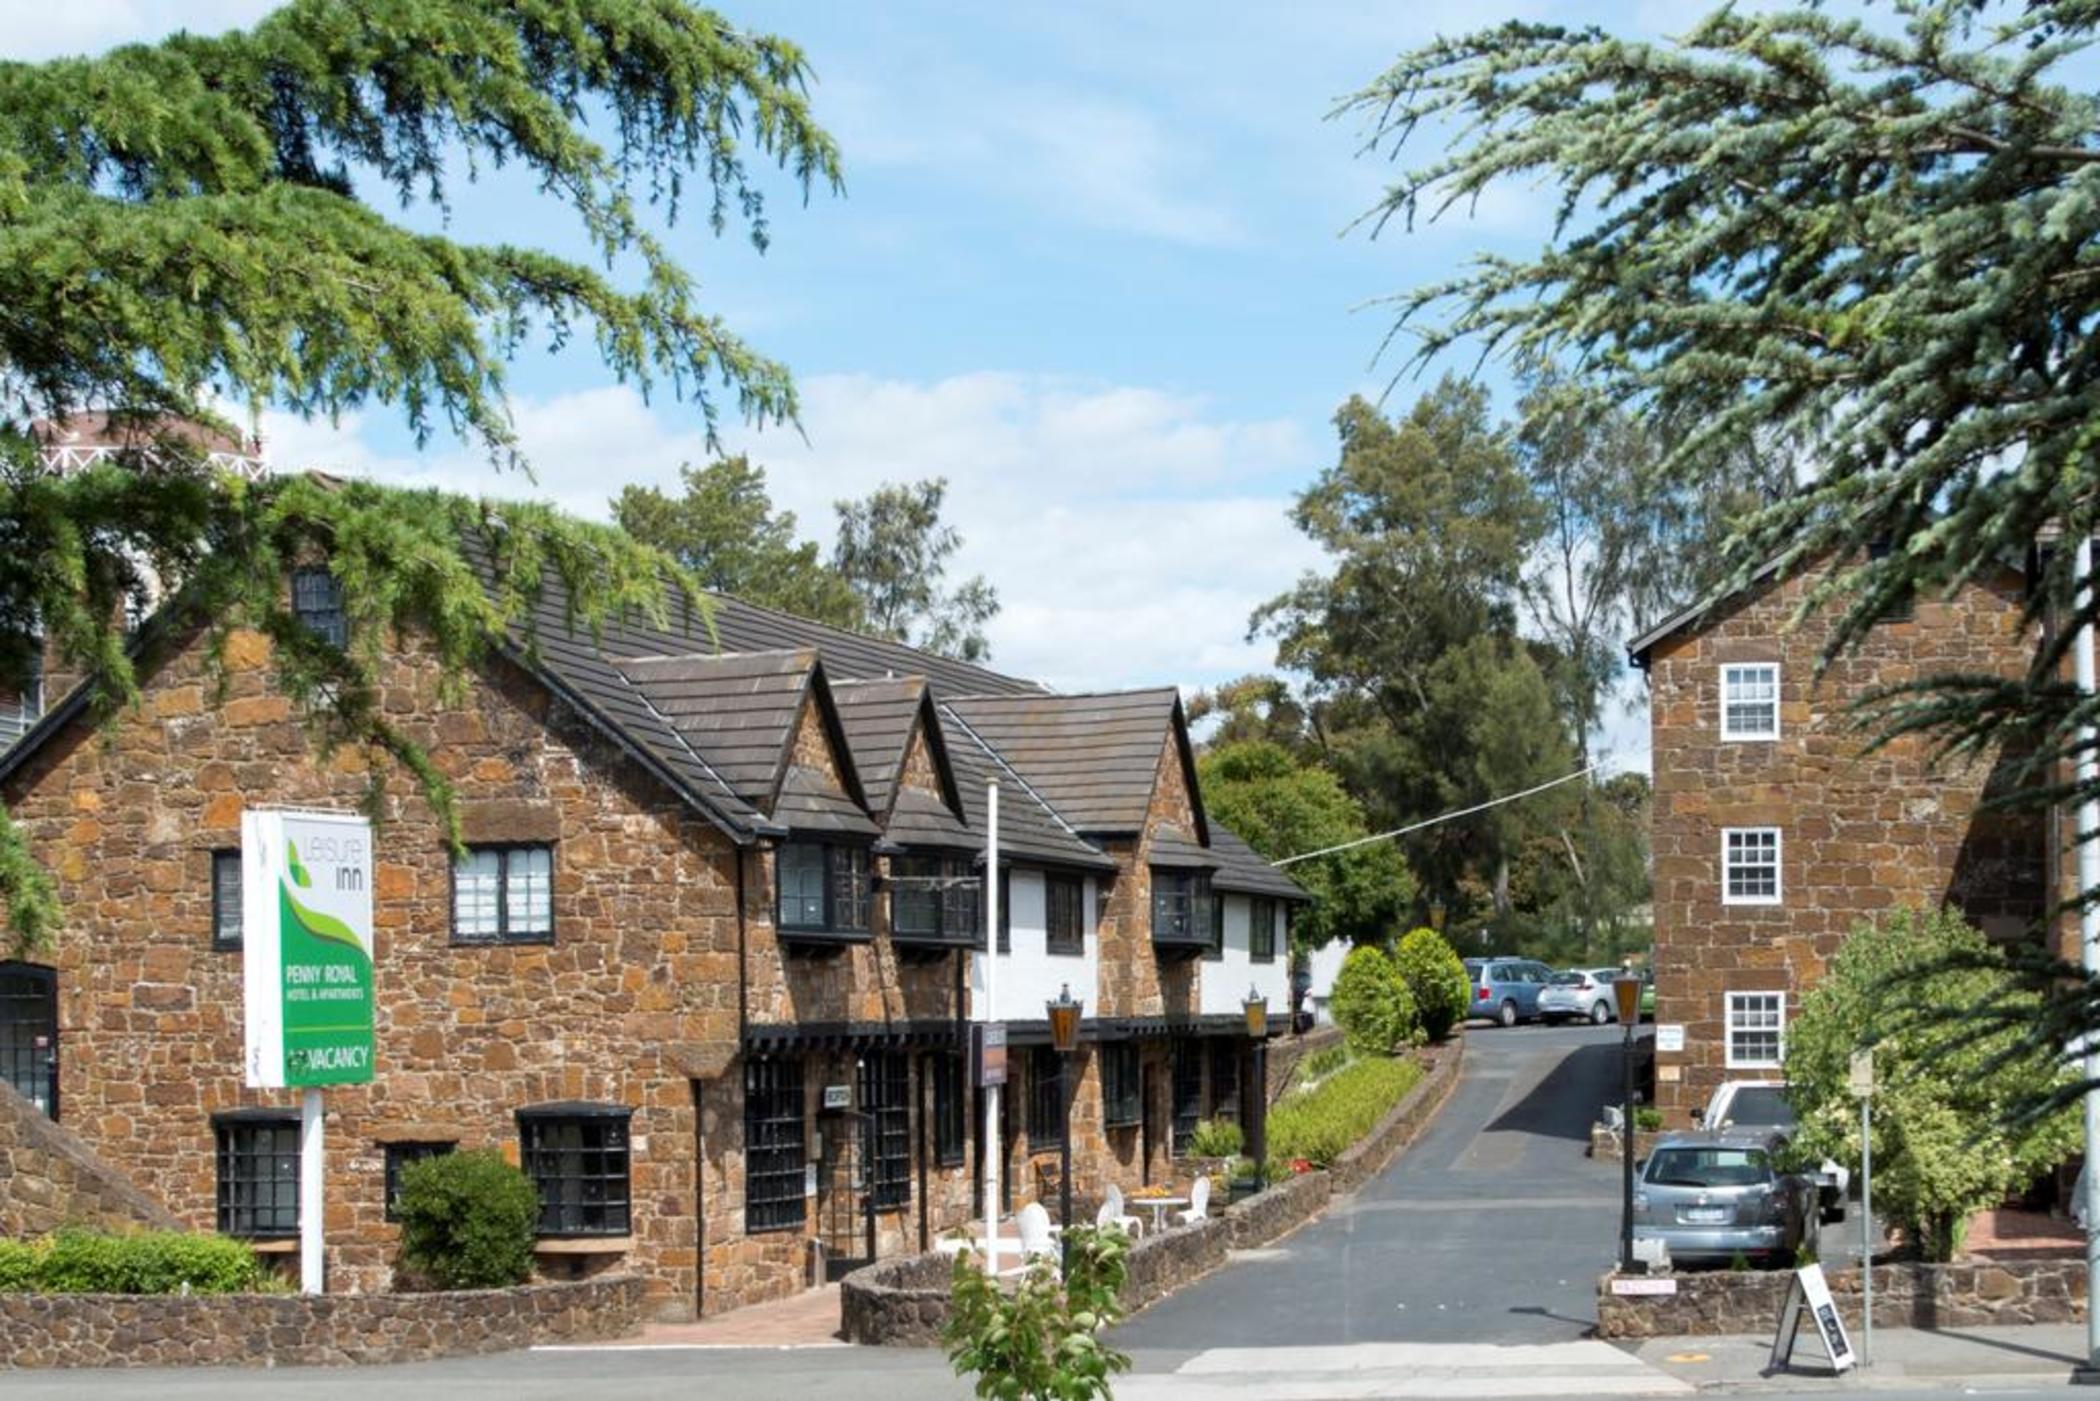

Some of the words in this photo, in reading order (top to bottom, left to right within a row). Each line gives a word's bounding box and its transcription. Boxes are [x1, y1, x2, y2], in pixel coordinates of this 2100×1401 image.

[286, 965, 320, 984] PENNY
[325, 964, 358, 983] ROYAL
[307, 1046, 369, 1070] VACANCY
